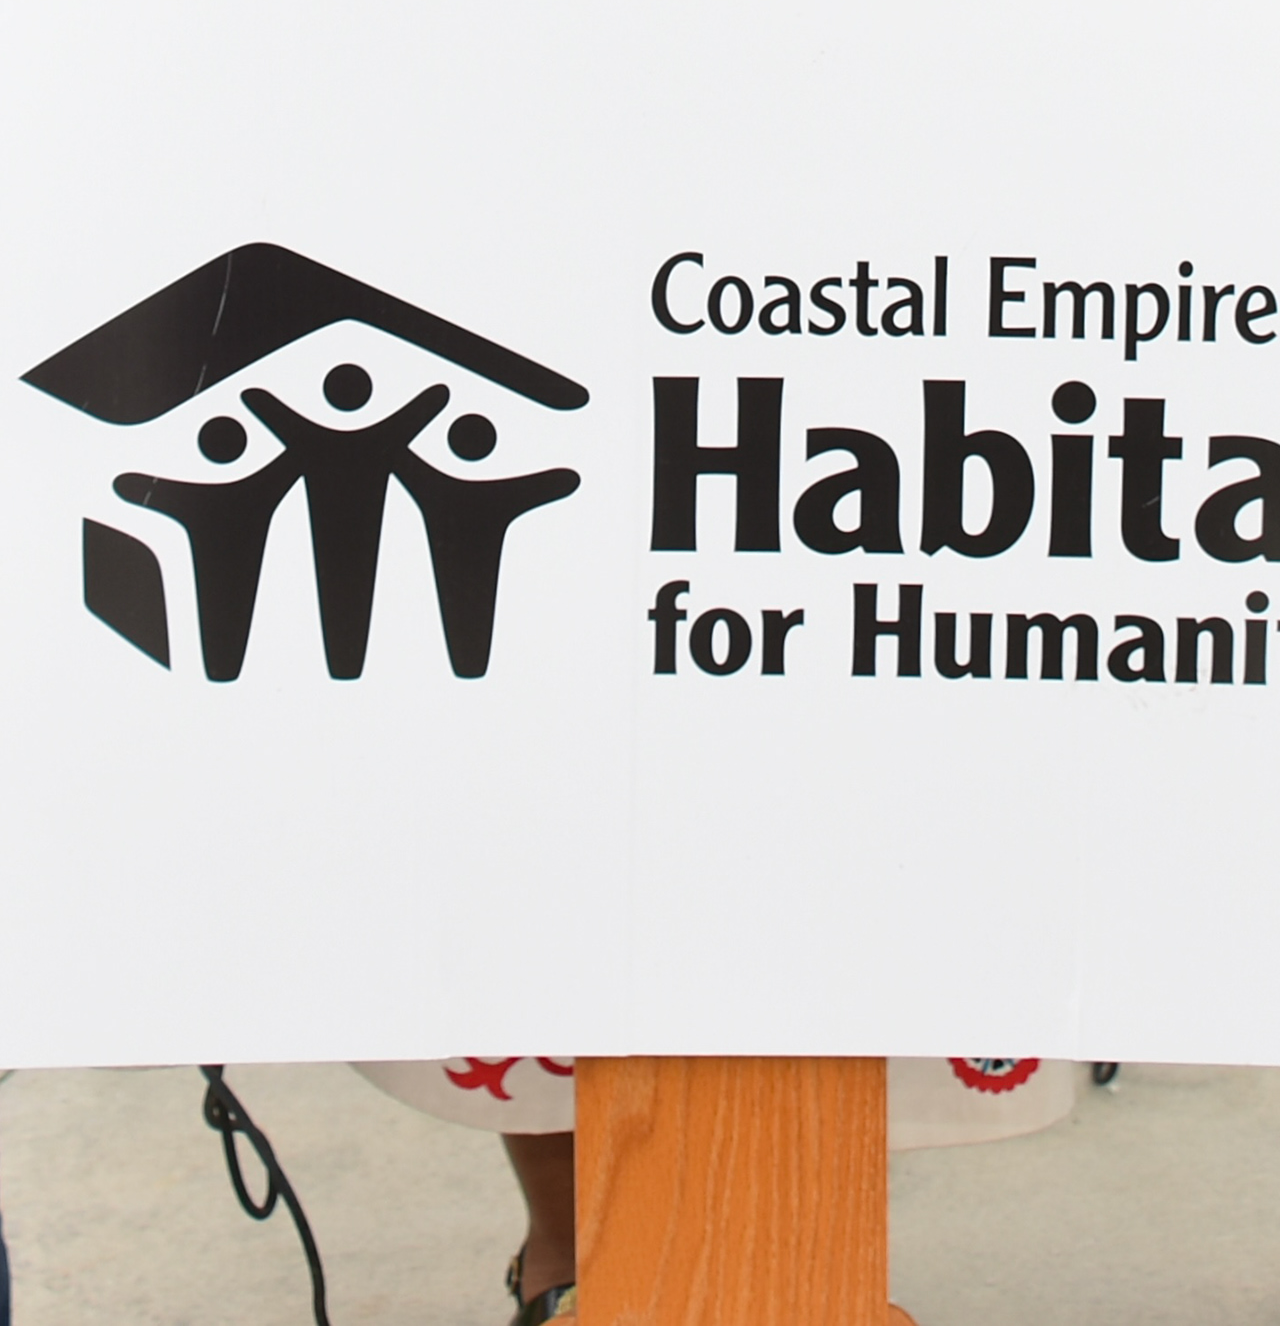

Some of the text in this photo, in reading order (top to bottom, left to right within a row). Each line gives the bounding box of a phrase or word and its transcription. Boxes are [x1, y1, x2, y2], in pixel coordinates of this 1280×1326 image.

[652, 252, 1277, 361] Coastal Empire
[648, 580, 804, 676] for
